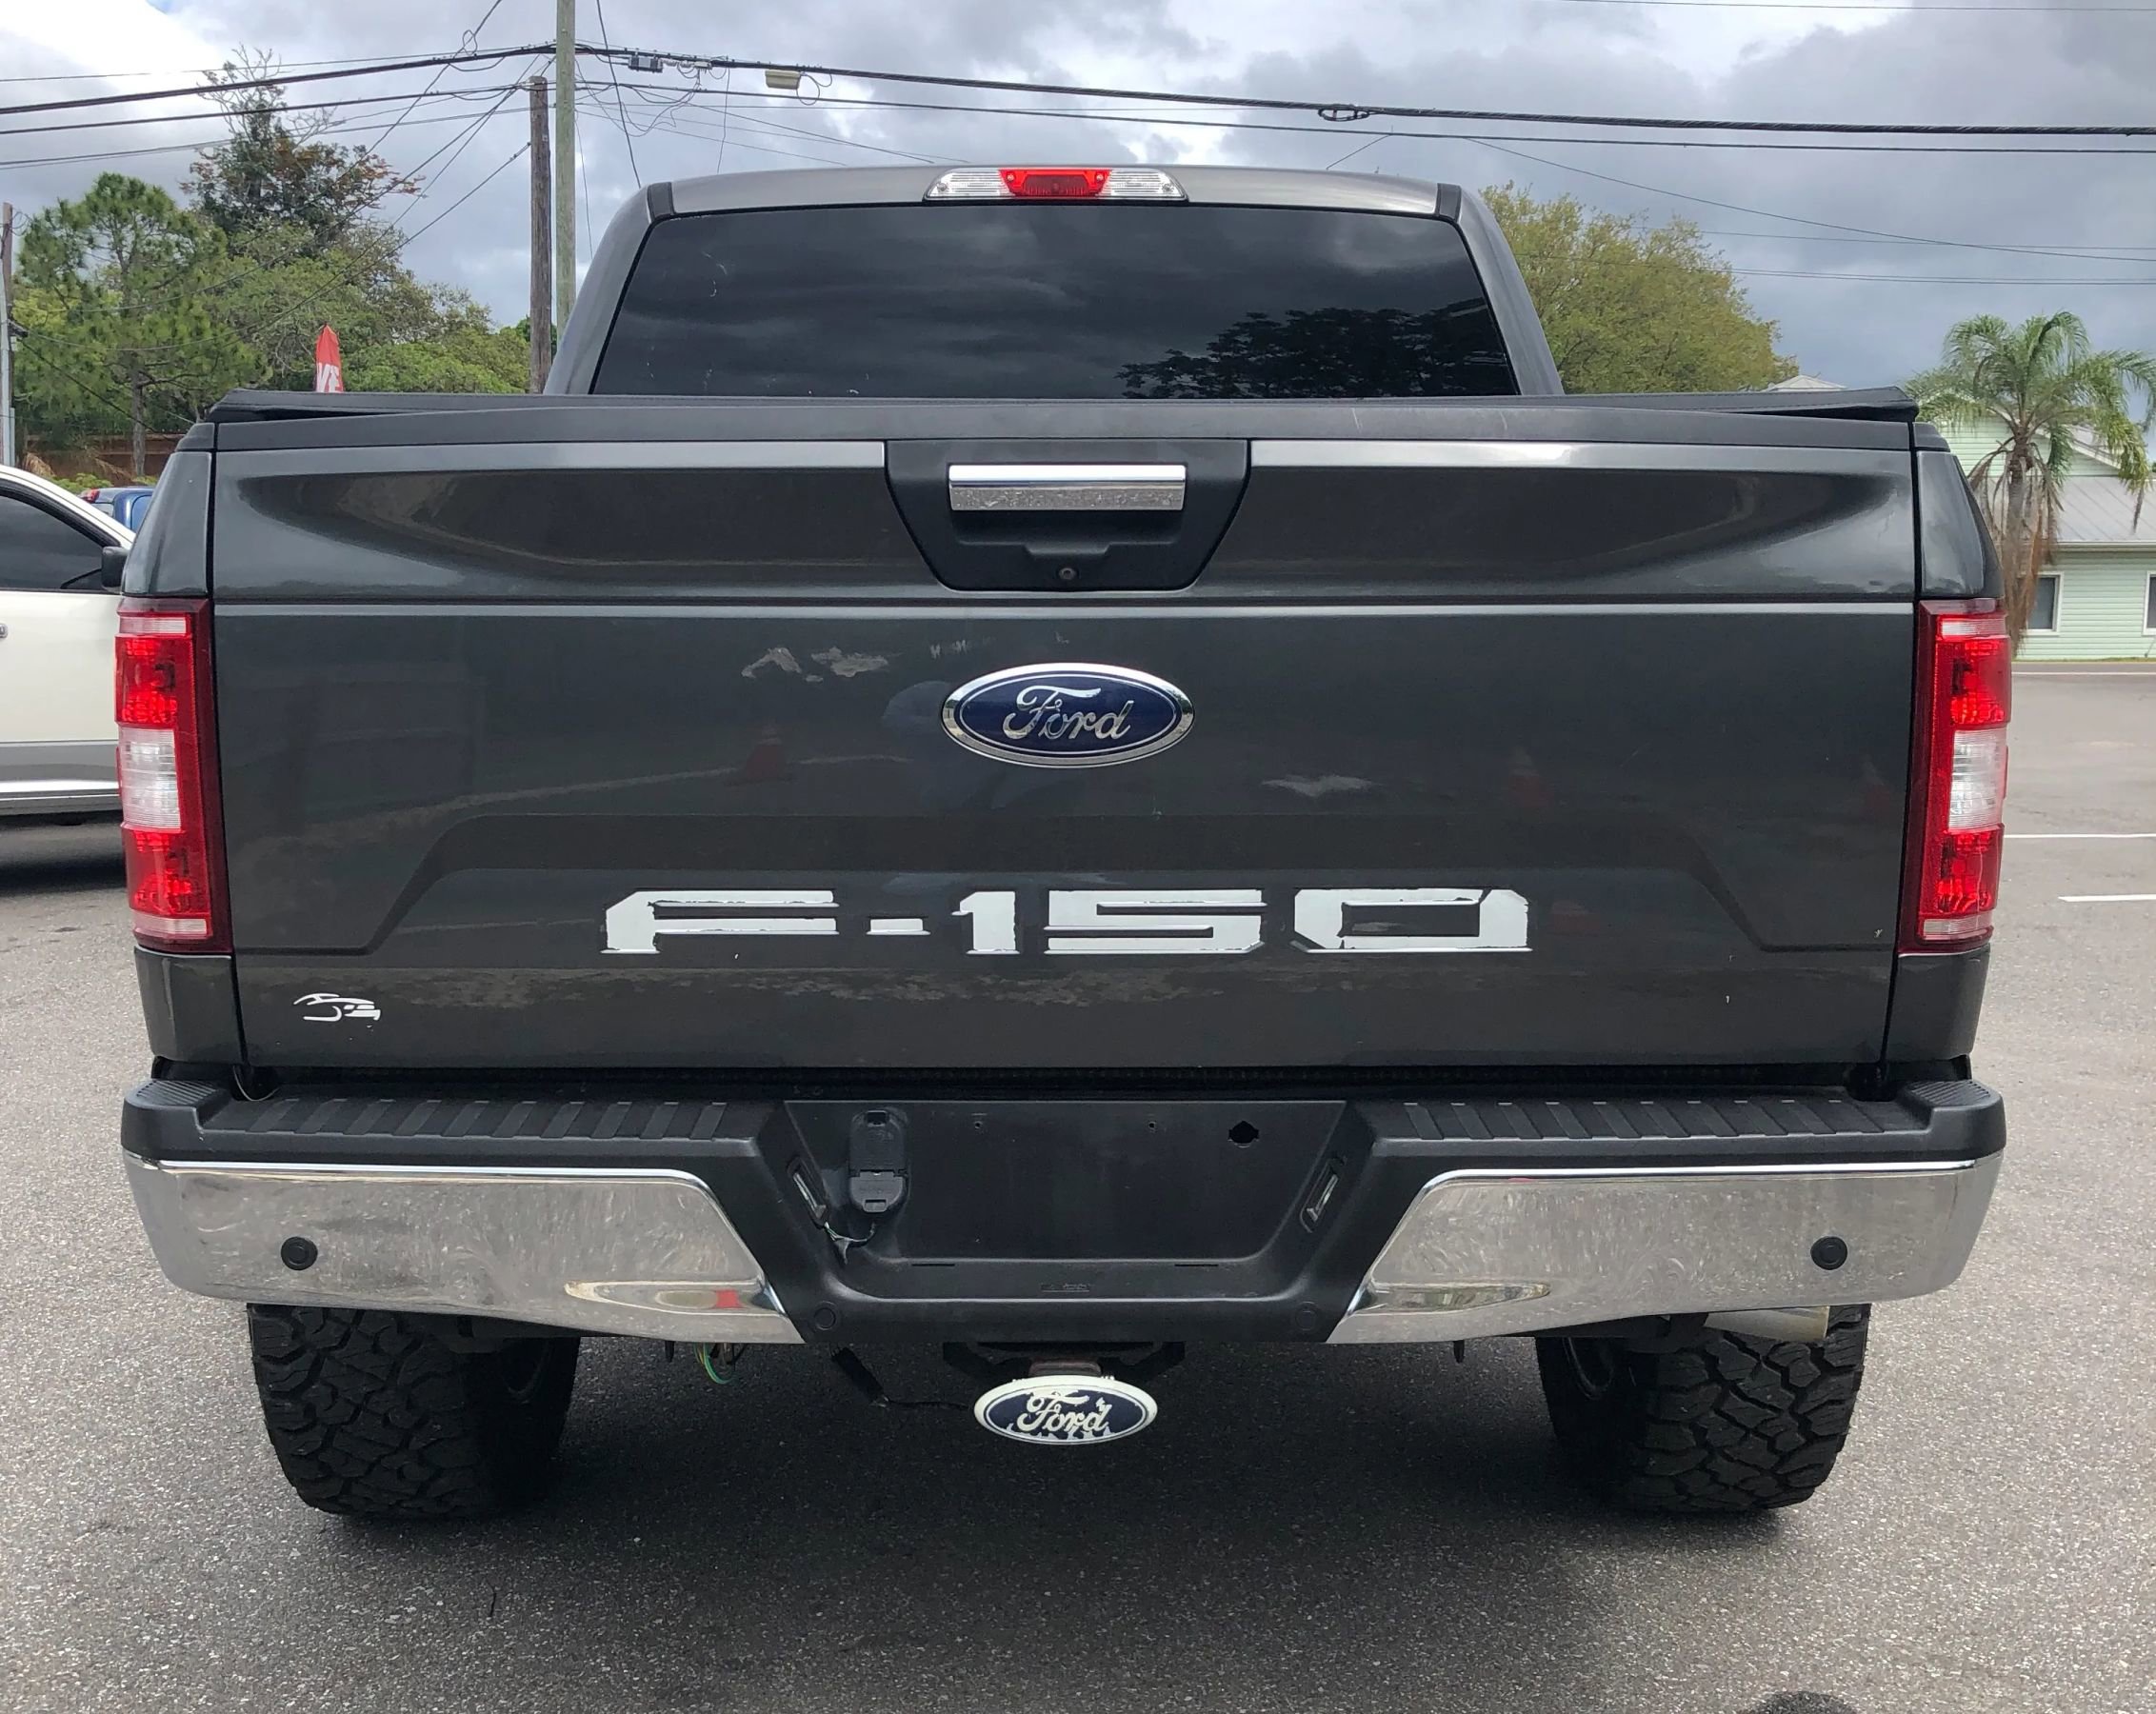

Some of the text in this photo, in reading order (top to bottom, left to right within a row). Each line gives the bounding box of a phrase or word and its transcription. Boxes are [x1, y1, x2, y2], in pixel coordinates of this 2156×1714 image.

[1003, 685, 1133, 740] Ford
[600, 888, 1533, 952] F-150
[1016, 1394, 1112, 1432] Ford
